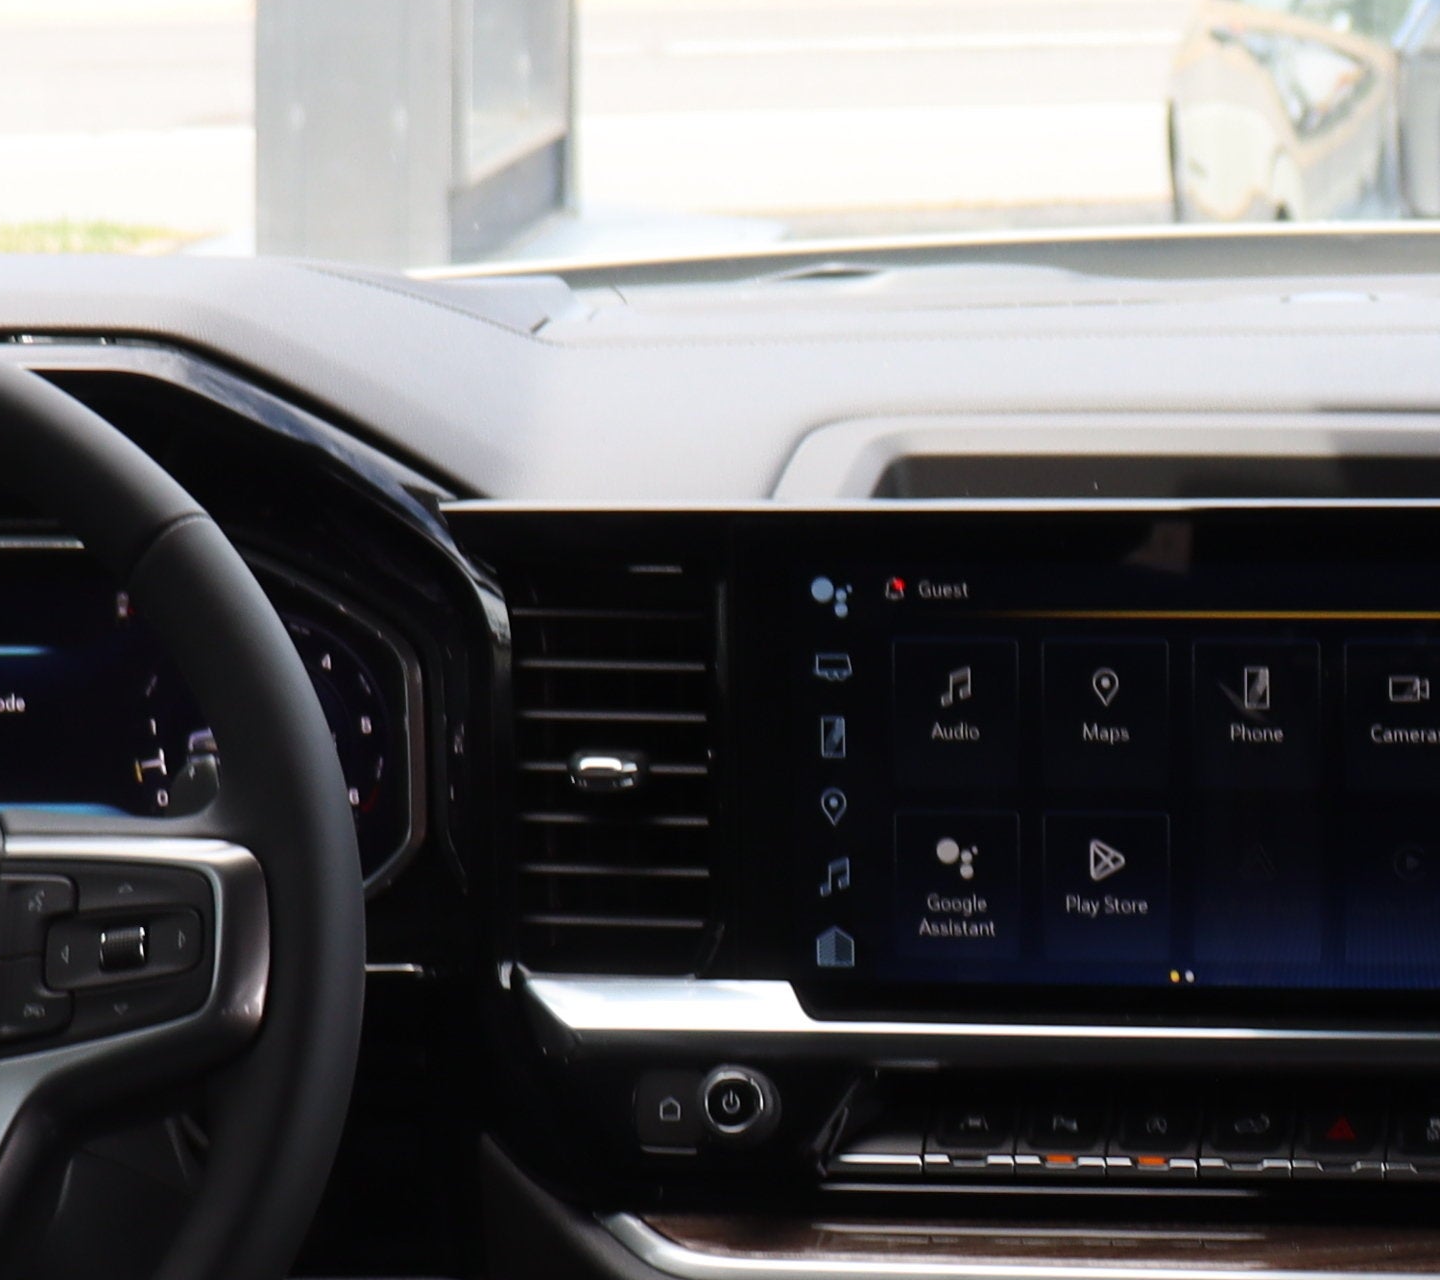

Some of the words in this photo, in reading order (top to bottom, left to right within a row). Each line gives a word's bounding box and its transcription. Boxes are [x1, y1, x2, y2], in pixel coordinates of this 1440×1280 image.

[918, 580, 969, 599] Guest
[321, 654, 333, 671] 4
[931, 723, 981, 742] Audio
[1083, 724, 1130, 745] Maps
[1230, 724, 1284, 743] Phone
[927, 895, 987, 915] Google
[1065, 896, 1099, 917] Play
[1104, 897, 1148, 915] Store
[919, 919, 996, 938] Assistant
